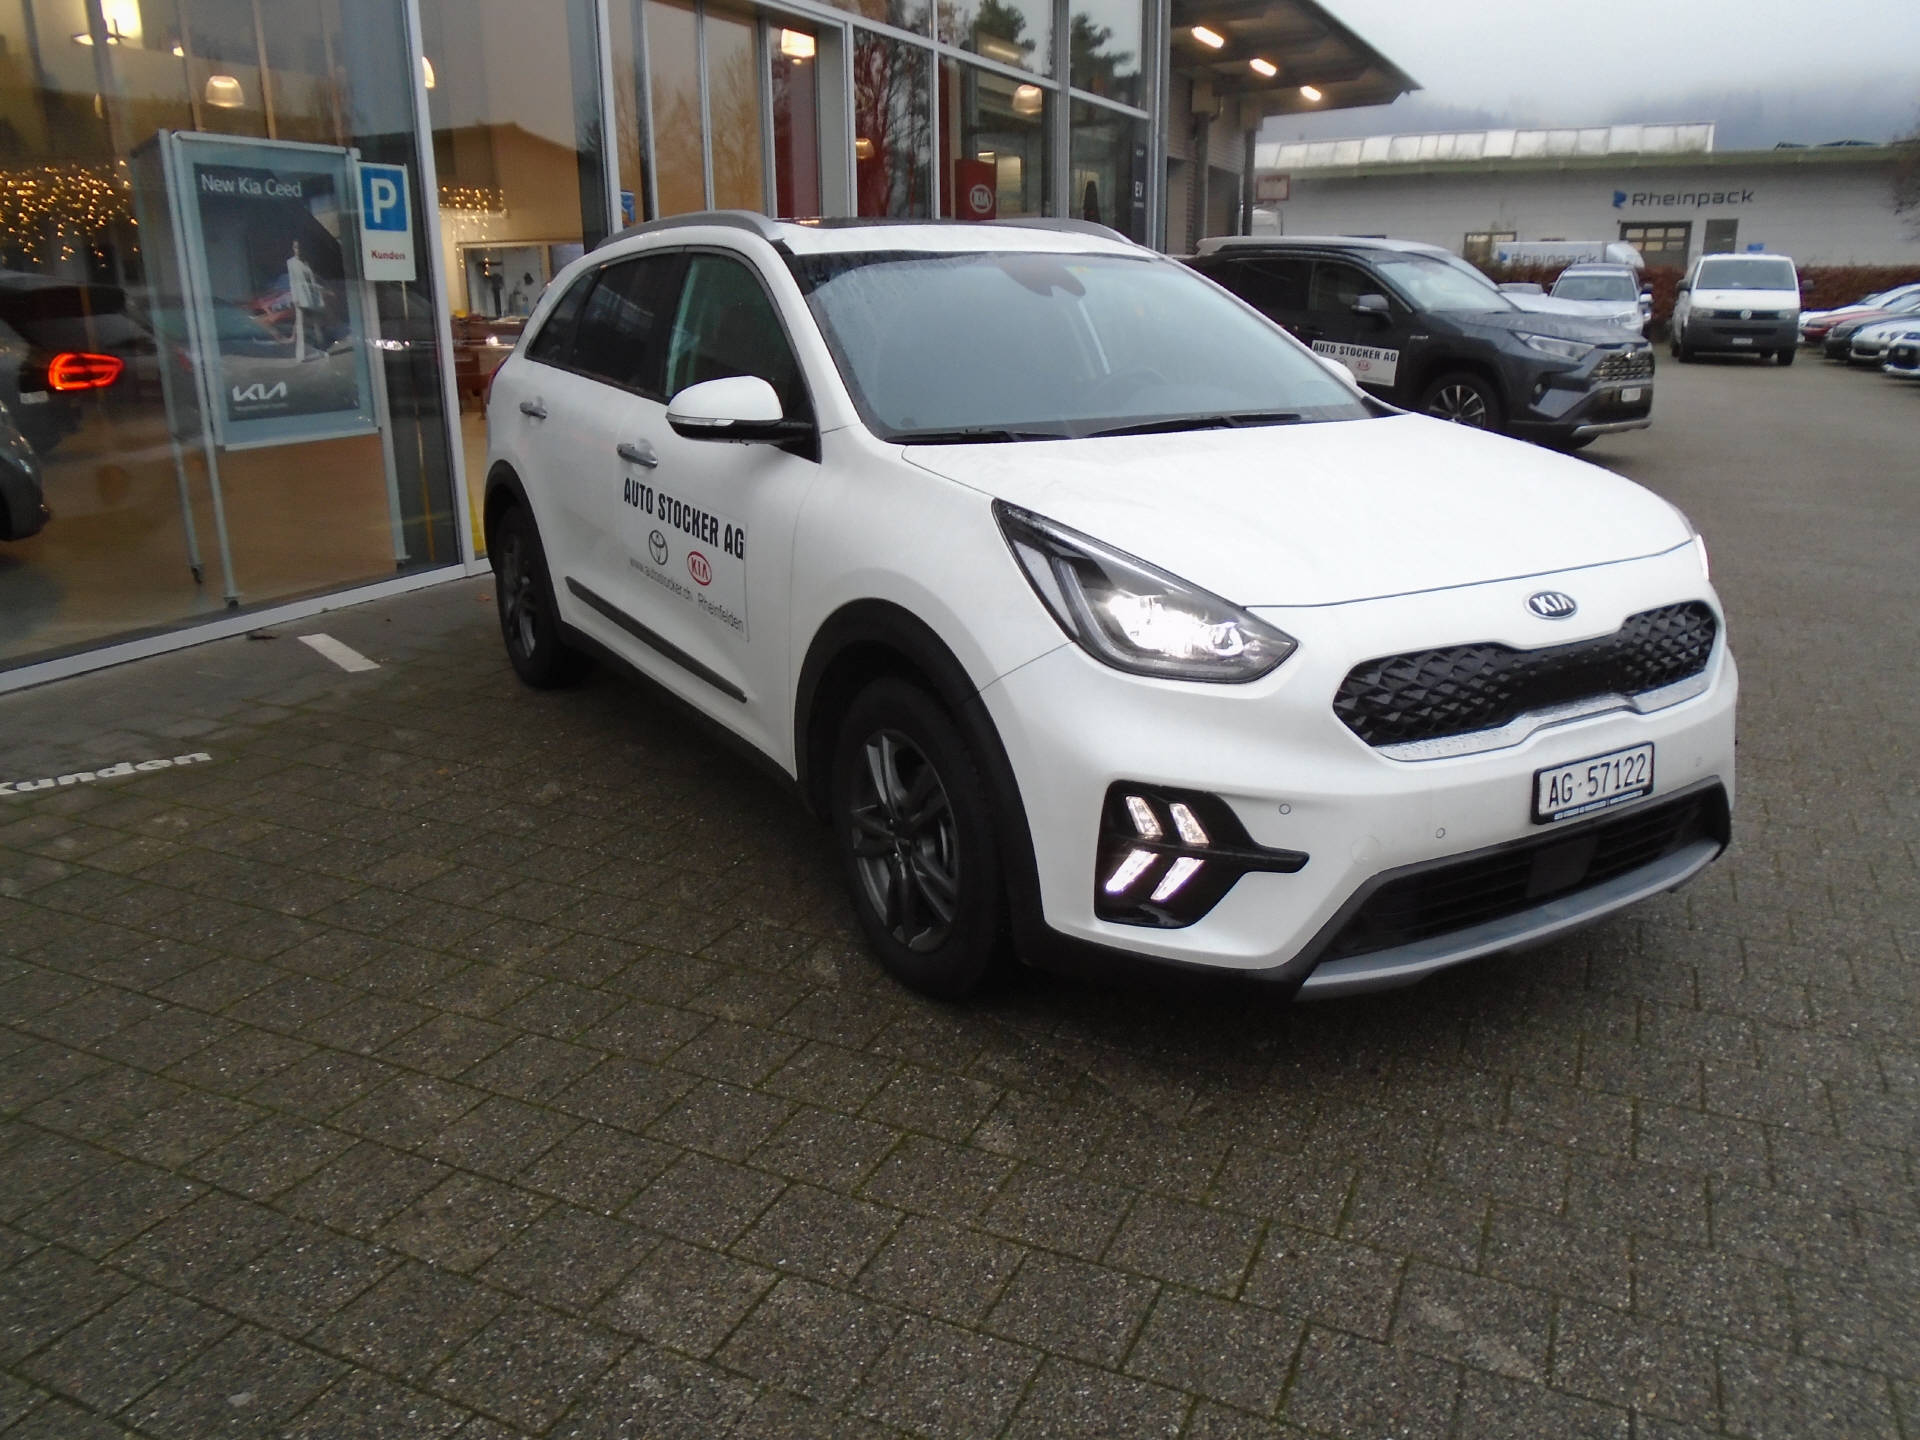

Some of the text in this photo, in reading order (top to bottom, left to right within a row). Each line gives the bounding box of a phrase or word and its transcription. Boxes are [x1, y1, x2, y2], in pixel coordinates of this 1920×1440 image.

[200, 173, 302, 198] New Kia Ceed
[371, 178, 397, 223] P
[1632, 189, 1754, 208] Rheinpack
[371, 249, 406, 260] Kunden
[1313, 342, 1336, 354] AUTO
[1339, 346, 1380, 359] STOCKER
[624, 477, 744, 560] AUTO STOCKER AG
[691, 557, 709, 581] KIA
[1531, 594, 1574, 614] KIA
[1587, 753, 1646, 797] 57122
